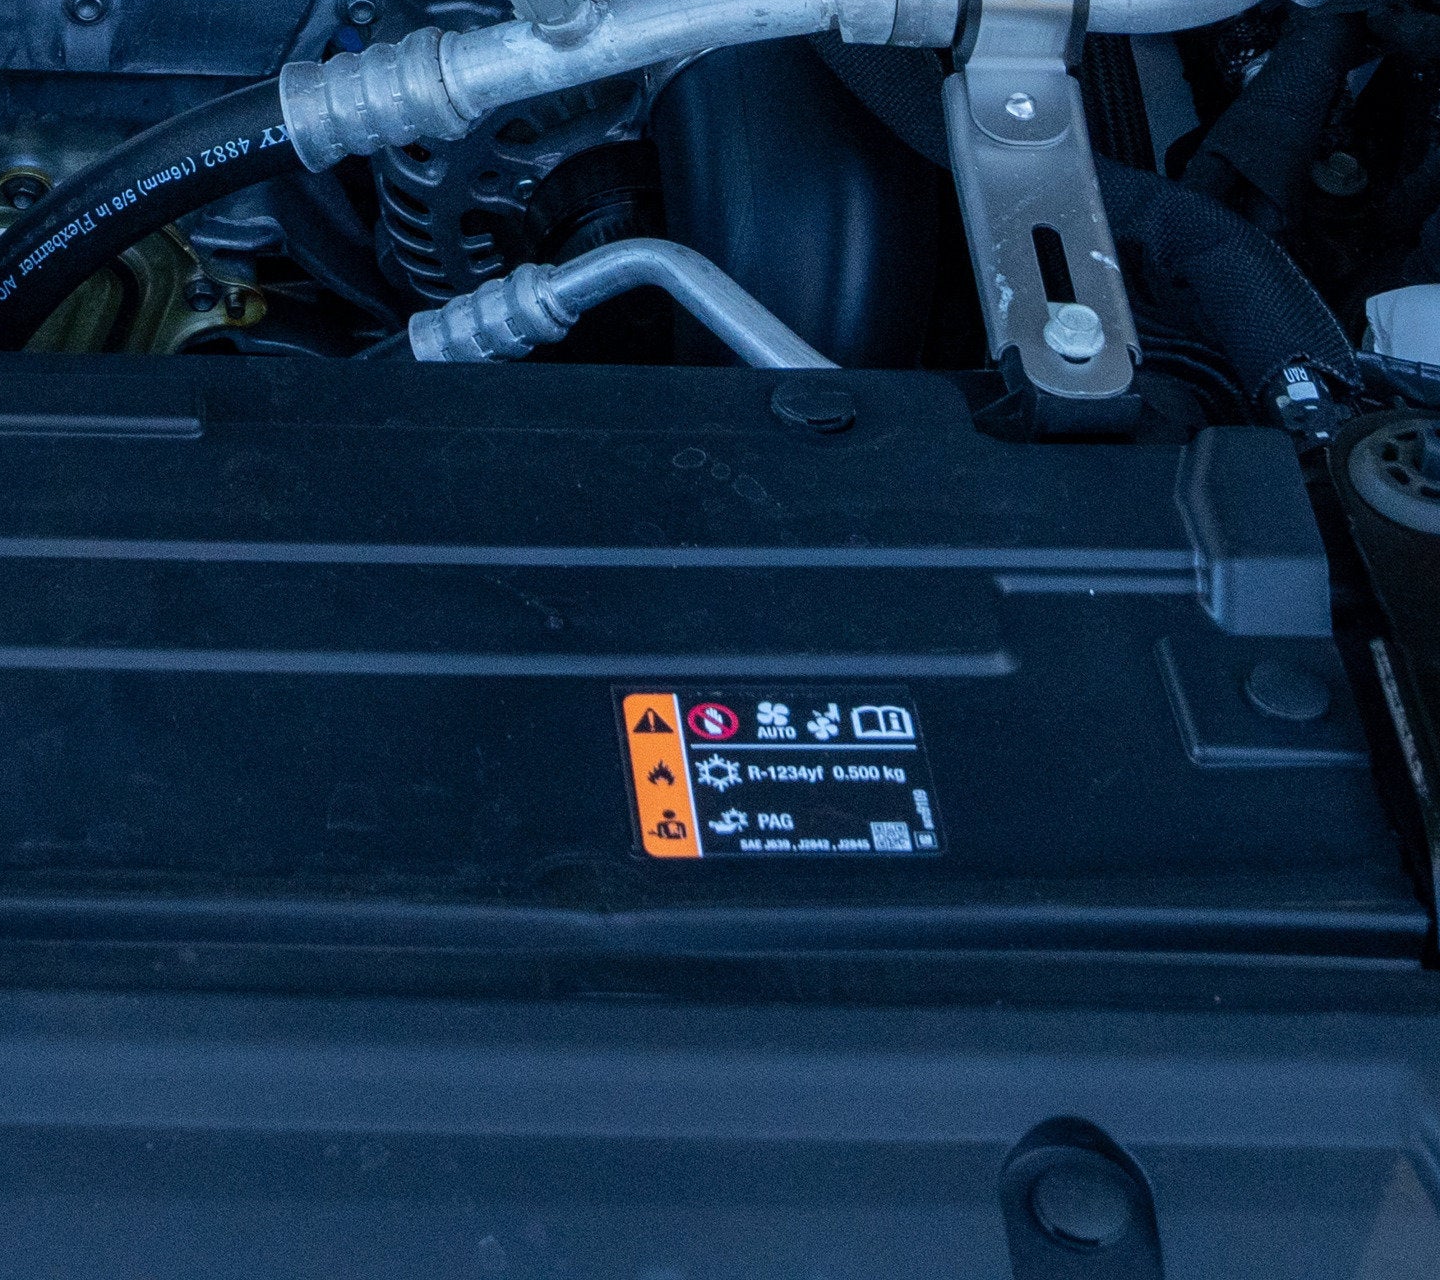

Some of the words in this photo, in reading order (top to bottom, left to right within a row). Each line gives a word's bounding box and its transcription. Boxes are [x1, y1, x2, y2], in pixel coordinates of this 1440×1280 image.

[201, 136, 251, 168] 4882
[112, 188, 138, 211] 5/8
[95, 202, 114, 218] in
[18, 211, 98, 277] Flexbarrier
[757, 725, 797, 740] AUTO
[747, 765, 824, 784] R-1234yf
[832, 765, 880, 781] 0.500
[883, 767, 907, 784] kg
[757, 813, 795, 831] PAG
